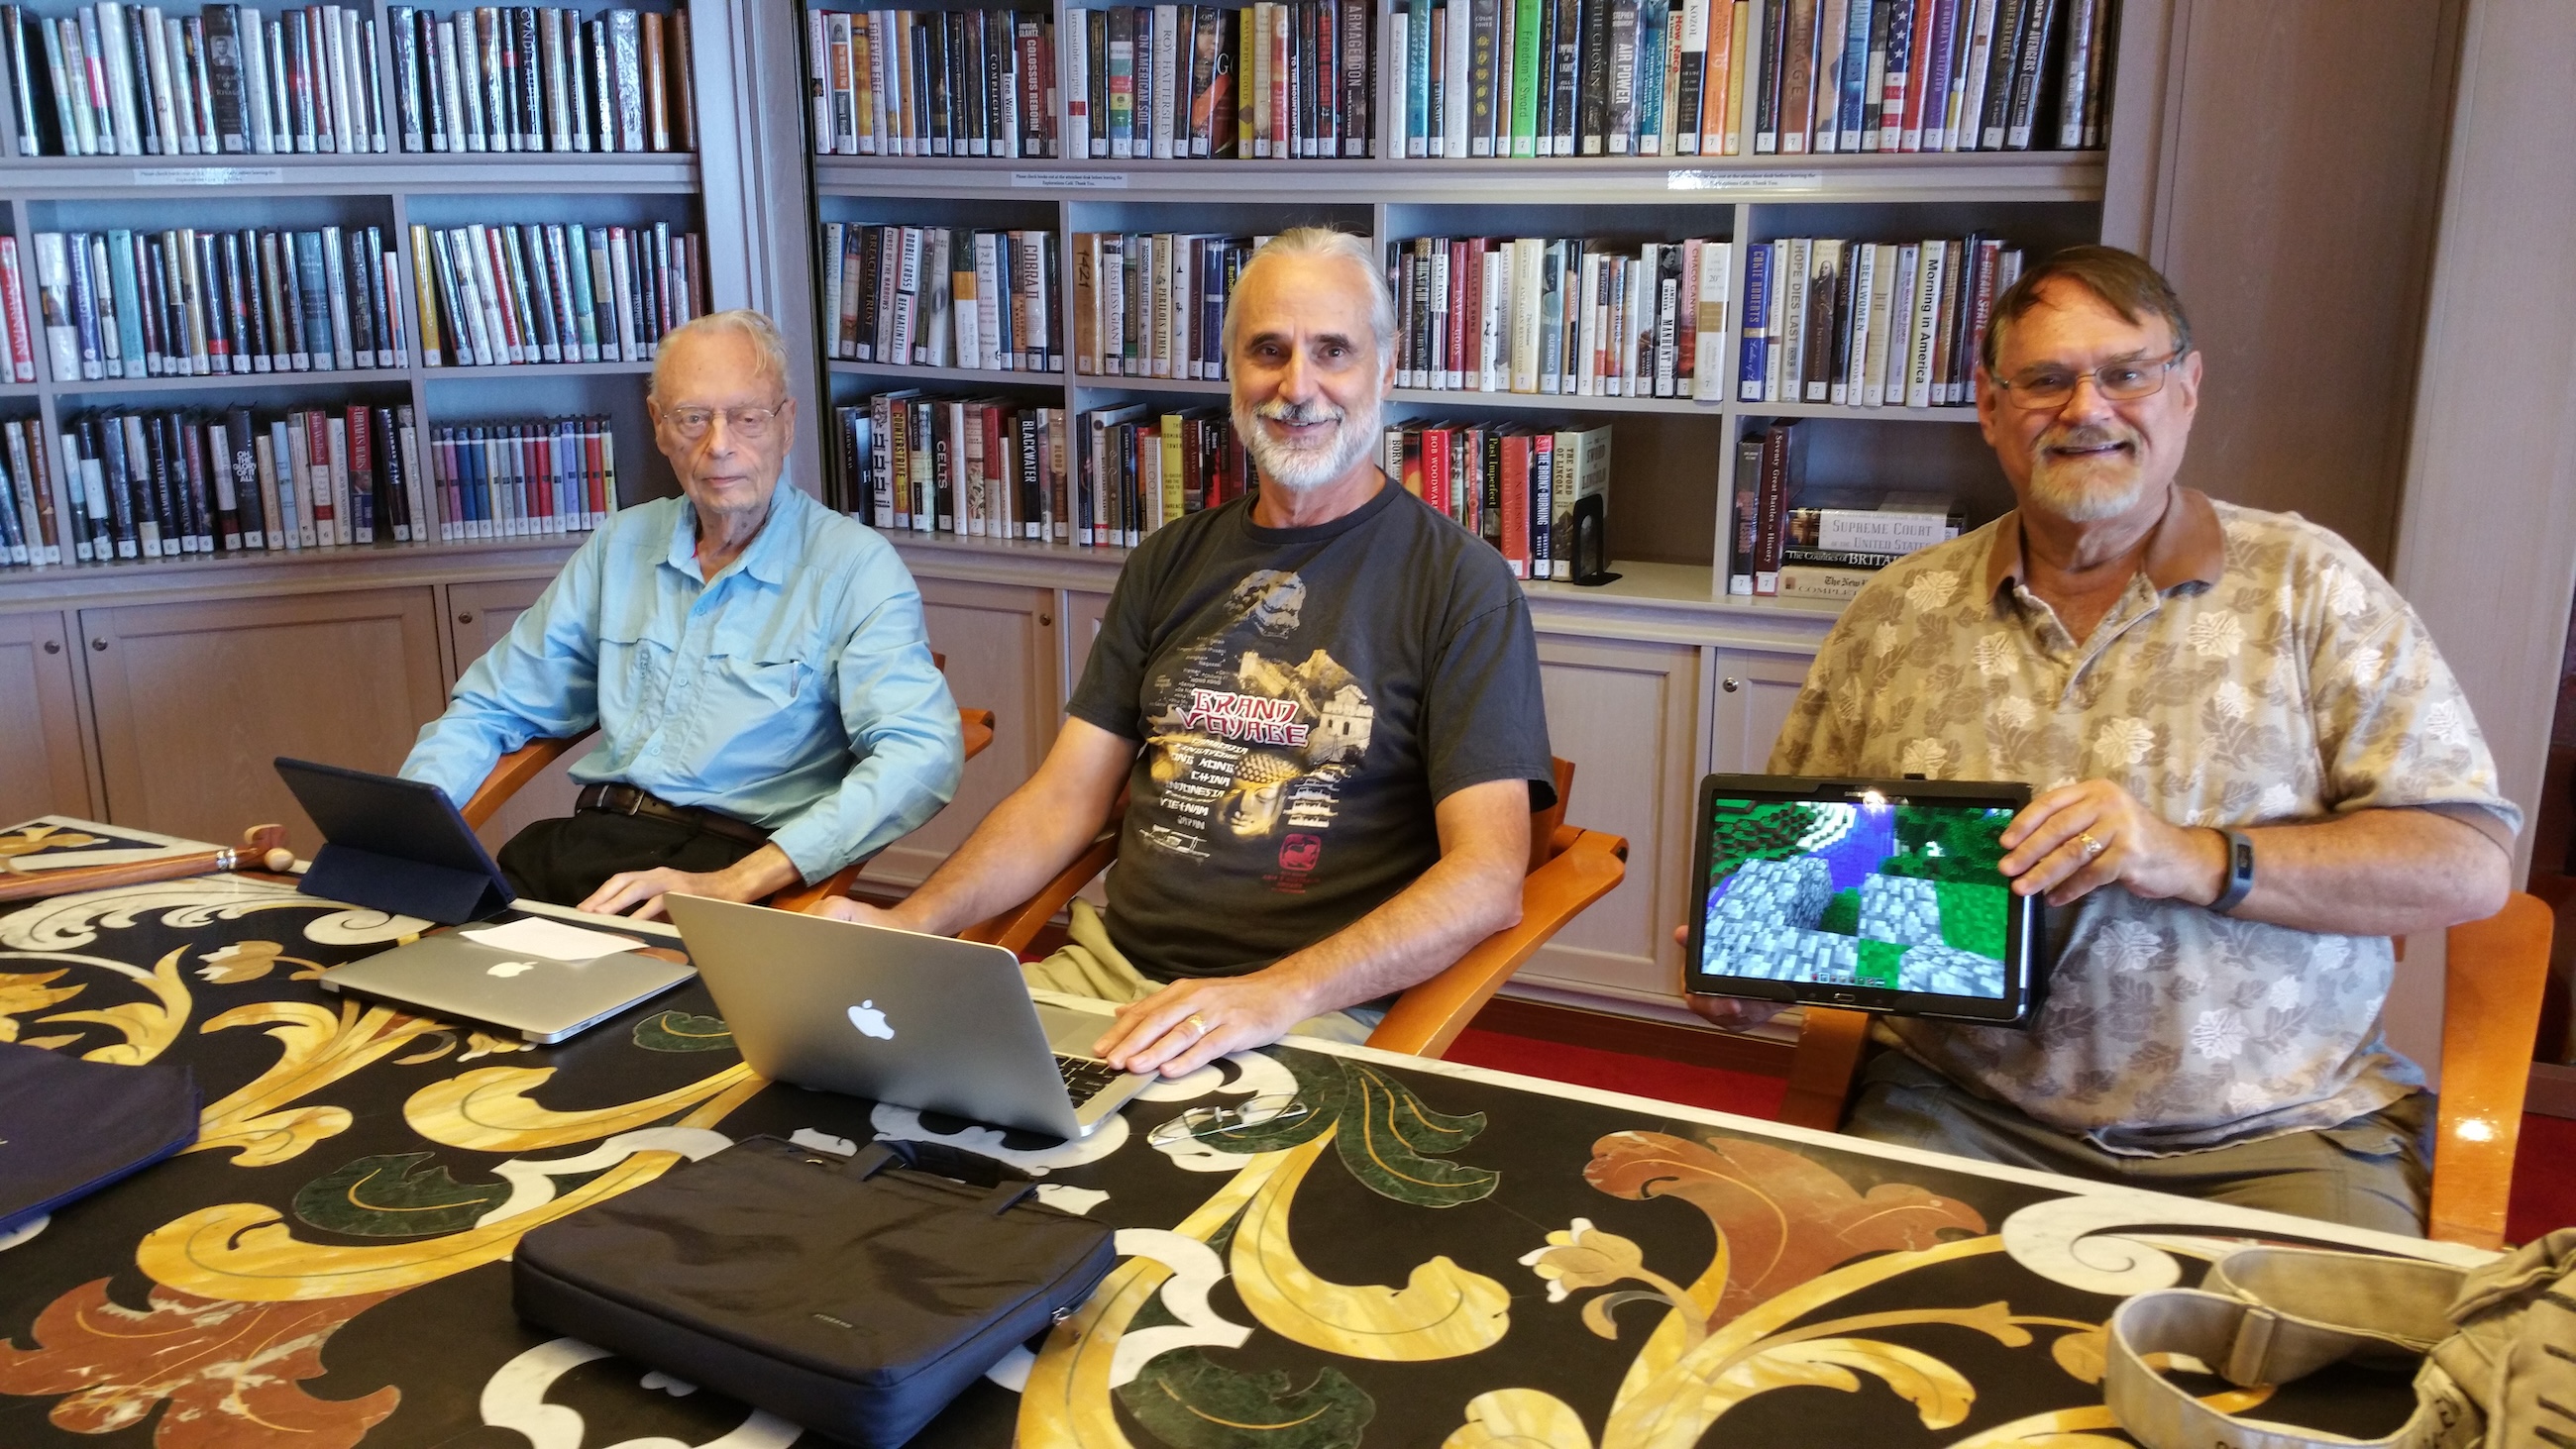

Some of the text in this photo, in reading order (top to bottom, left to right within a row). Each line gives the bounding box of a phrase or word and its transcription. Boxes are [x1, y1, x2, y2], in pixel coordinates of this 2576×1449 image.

[1689, 4, 1699, 38] KOZOL
[519, 9, 537, 112] CYNDI LAUPER
[869, 22, 882, 95] FOREVER FREE
[1071, 14, 1081, 96] irresistible empire
[1291, 55, 1297, 66] TO
[1347, 6, 1362, 87] ARMAGEDDON
[1410, 37, 1419, 87] STRANGE
[1589, 4, 1603, 87] THE CHOSEN
[1618, 44, 1633, 62] AIR
[1673, 46, 1682, 73] Race
[1790, 10, 1810, 96] MIRAGE
[2022, 30, 2040, 72] AVENGERS
[990, 53, 1000, 126] COMPLICITY
[1027, 39, 1039, 132] COLOSSUS REBORN
[1136, 35, 1149, 126] ON AMERICAN SOIL
[1161, 30, 1172, 138] ROY HATTERSLEY
[1519, 31, 1532, 118] Freedom's Sword
[1615, 64, 1633, 104] POWER
[1433, 82, 1443, 122] ransom
[885, 229, 894, 251] CURSE
[885, 252, 892, 260] OF
[902, 233, 915, 288] DOUBLE CROSS
[865, 234, 878, 327] BREACH TRUST
[1023, 245, 1039, 300] COBRA II
[1076, 250, 1091, 288] 1421
[1599, 268, 1608, 305] Waterloo
[1688, 248, 1699, 325] CHACO CANYON
[1749, 251, 1765, 323] COKIE ROBERTS
[1839, 266, 1849, 307] HEROES
[1979, 260, 1992, 298] DREAM
[882, 276, 891, 311] NARROWS
[897, 297, 908, 312] BEN
[1110, 261, 1122, 348] RESTLESS GIANT
[1141, 308, 1149, 317] #1
[1788, 246, 1804, 344] HOPE DIES LAST
[1856, 263, 1871, 332] BELLWOMEN
[1158, 287, 1167, 356] PERILOUS TIMES
[1660, 319, 1673, 362] MANHUNT
[1914, 259, 1939, 385] Morning in America
[1546, 333, 1556, 372] GUERNICA
[354, 411, 367, 469] OBAMA'S WARS
[893, 412, 907, 478] COUNTERSTRIKE
[1021, 420, 1036, 482] BLACKWATER
[1392, 439, 1403, 465] BORN
[1430, 435, 1439, 454] BOB
[1565, 448, 1574, 465] THE
[388, 461, 399, 485] ZIM
[935, 440, 948, 489] CELTS
[1147, 464, 1157, 496] LOOT
[1487, 437, 1499, 506] Past Imperfect
[1504, 440, 1514, 495] AFTER THE
[1556, 448, 1564, 495] OF LINCOLN
[158, 476, 171, 517] BEETHOVEN
[1536, 452, 1550, 526] THE BRONX BURNING
[1764, 434, 1783, 563] Seventy Great Battles History
[1514, 493, 1524, 532] WILSON
[1832, 519, 1932, 536] SUPREME COURT
[1785, 550, 1839, 563] The Counties
[1854, 538, 1891, 550] UNITED
[1824, 574, 1861, 586] The New
[1191, 686, 1300, 724] GRAND
[1176, 706, 1310, 748] VOYAGE
[1192, 737, 1249, 756] CAMBODIA
[1191, 771, 1232, 787] CHINA
[1198, 758, 1236, 775] KONG
[1159, 797, 1210, 817] VIETNAM
[1166, 780, 1226, 798] INDONESIA
[1177, 815, 1207, 830] JAPAN
